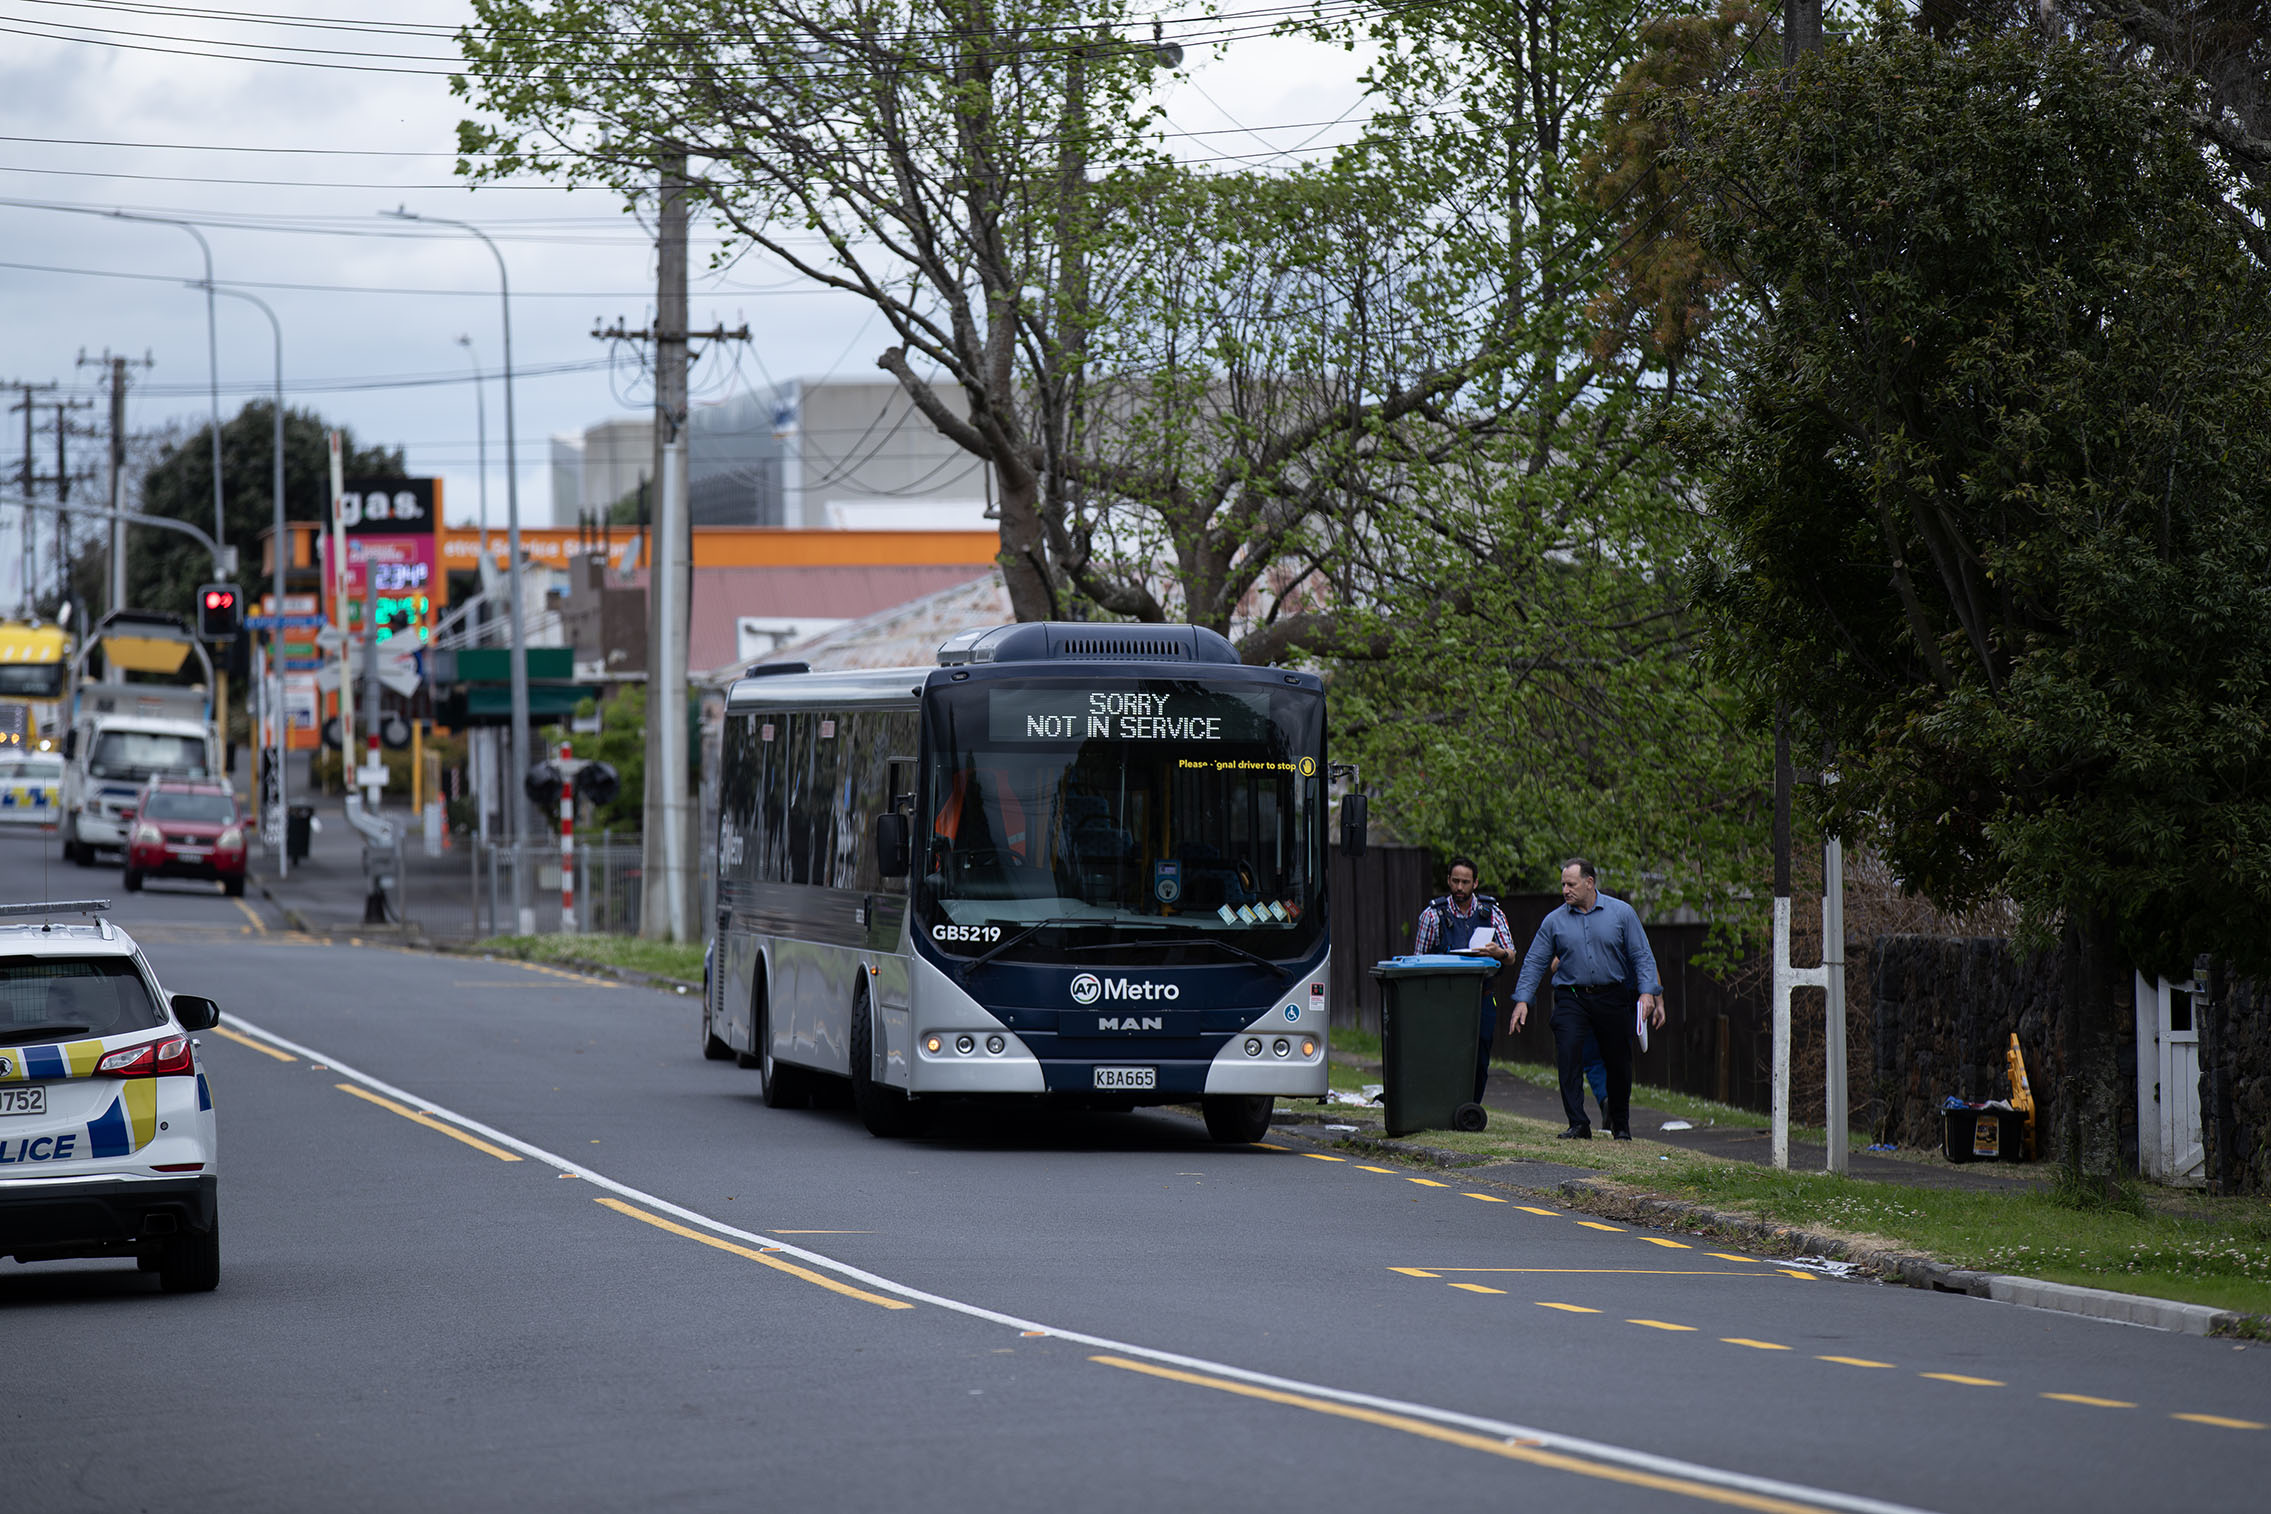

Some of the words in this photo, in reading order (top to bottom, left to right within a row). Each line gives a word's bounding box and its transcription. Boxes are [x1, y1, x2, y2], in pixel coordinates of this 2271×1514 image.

[1089, 692, 1170, 715] SORRY
[1027, 715, 1077, 738] NOT
[1087, 715, 1110, 738] IN
[1120, 716, 1221, 739] SERVICE
[1238, 760, 1264, 770] driver
[1266, 762, 1276, 770] to
[1277, 762, 1297, 773] stop
[932, 924, 1001, 942] GB5219
[1104, 978, 1180, 1000] Metro
[1098, 1017, 1162, 1031] MAN
[1096, 1071, 1154, 1086] KBA665
[0, 1090, 42, 1112] 752
[0, 1134, 77, 1164] LICE
